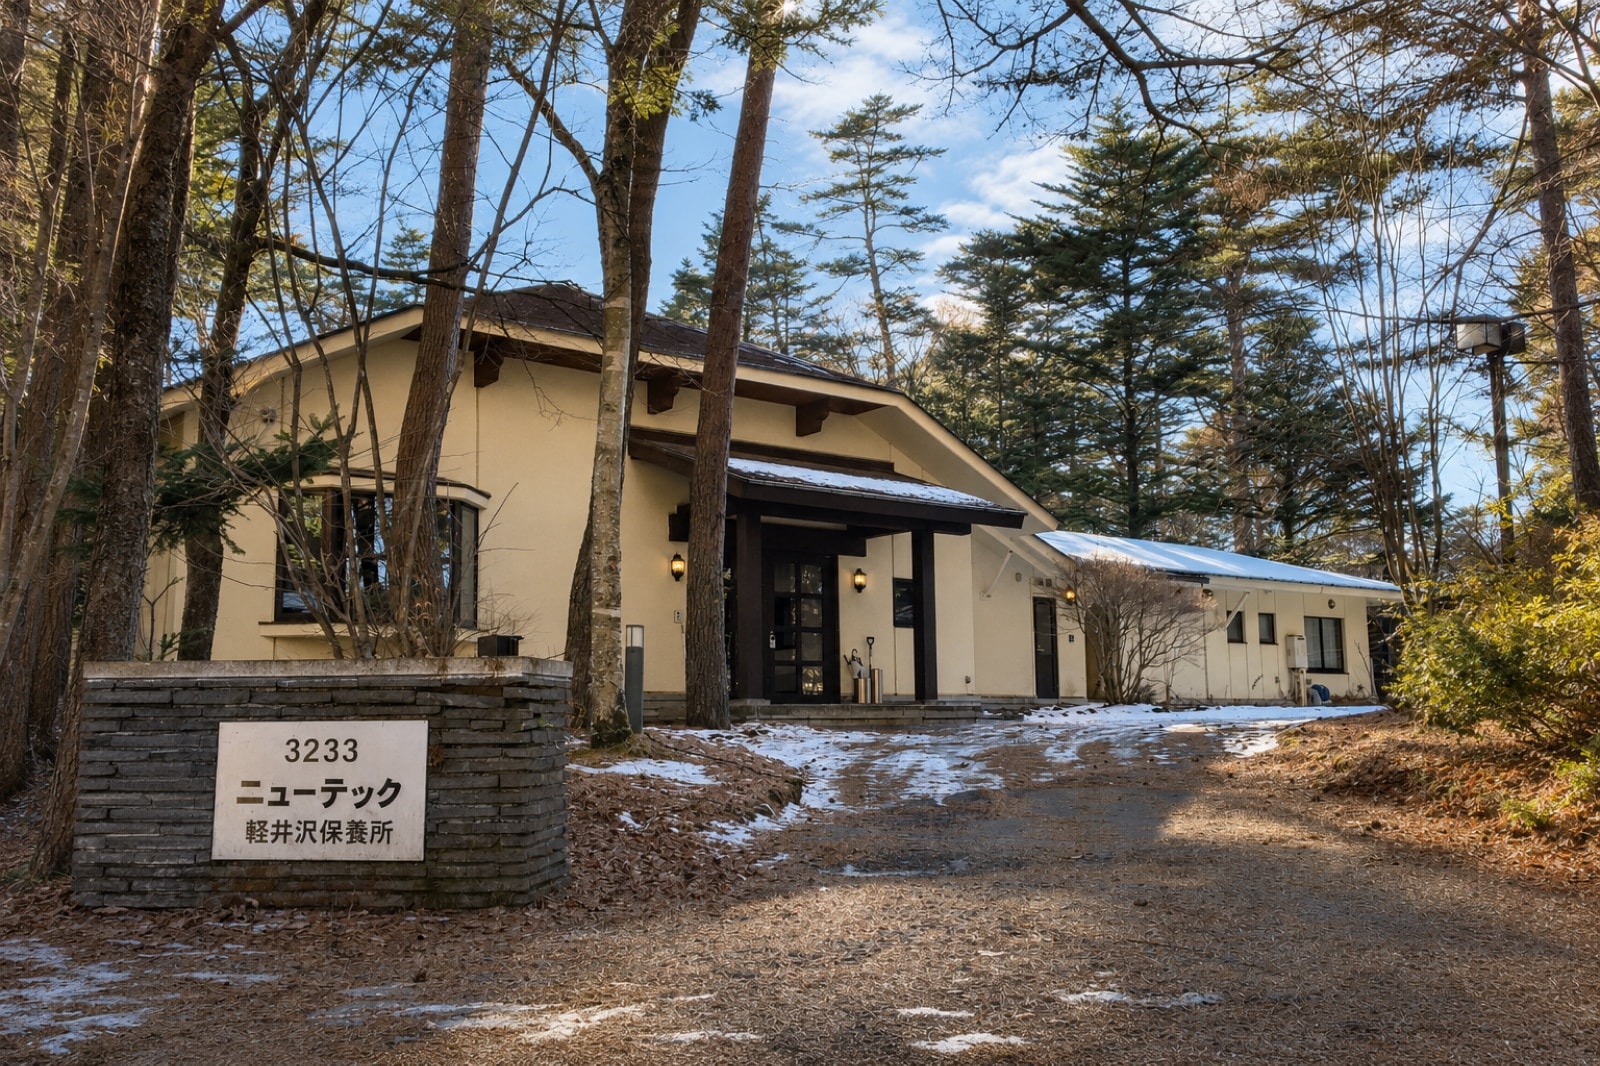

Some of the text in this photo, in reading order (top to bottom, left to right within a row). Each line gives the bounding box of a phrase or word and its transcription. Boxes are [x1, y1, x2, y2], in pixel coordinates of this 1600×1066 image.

[284, 738, 359, 762] 3233
[236, 777, 402, 809] ニューテック
[245, 819, 394, 845] 軽井沢保養所
